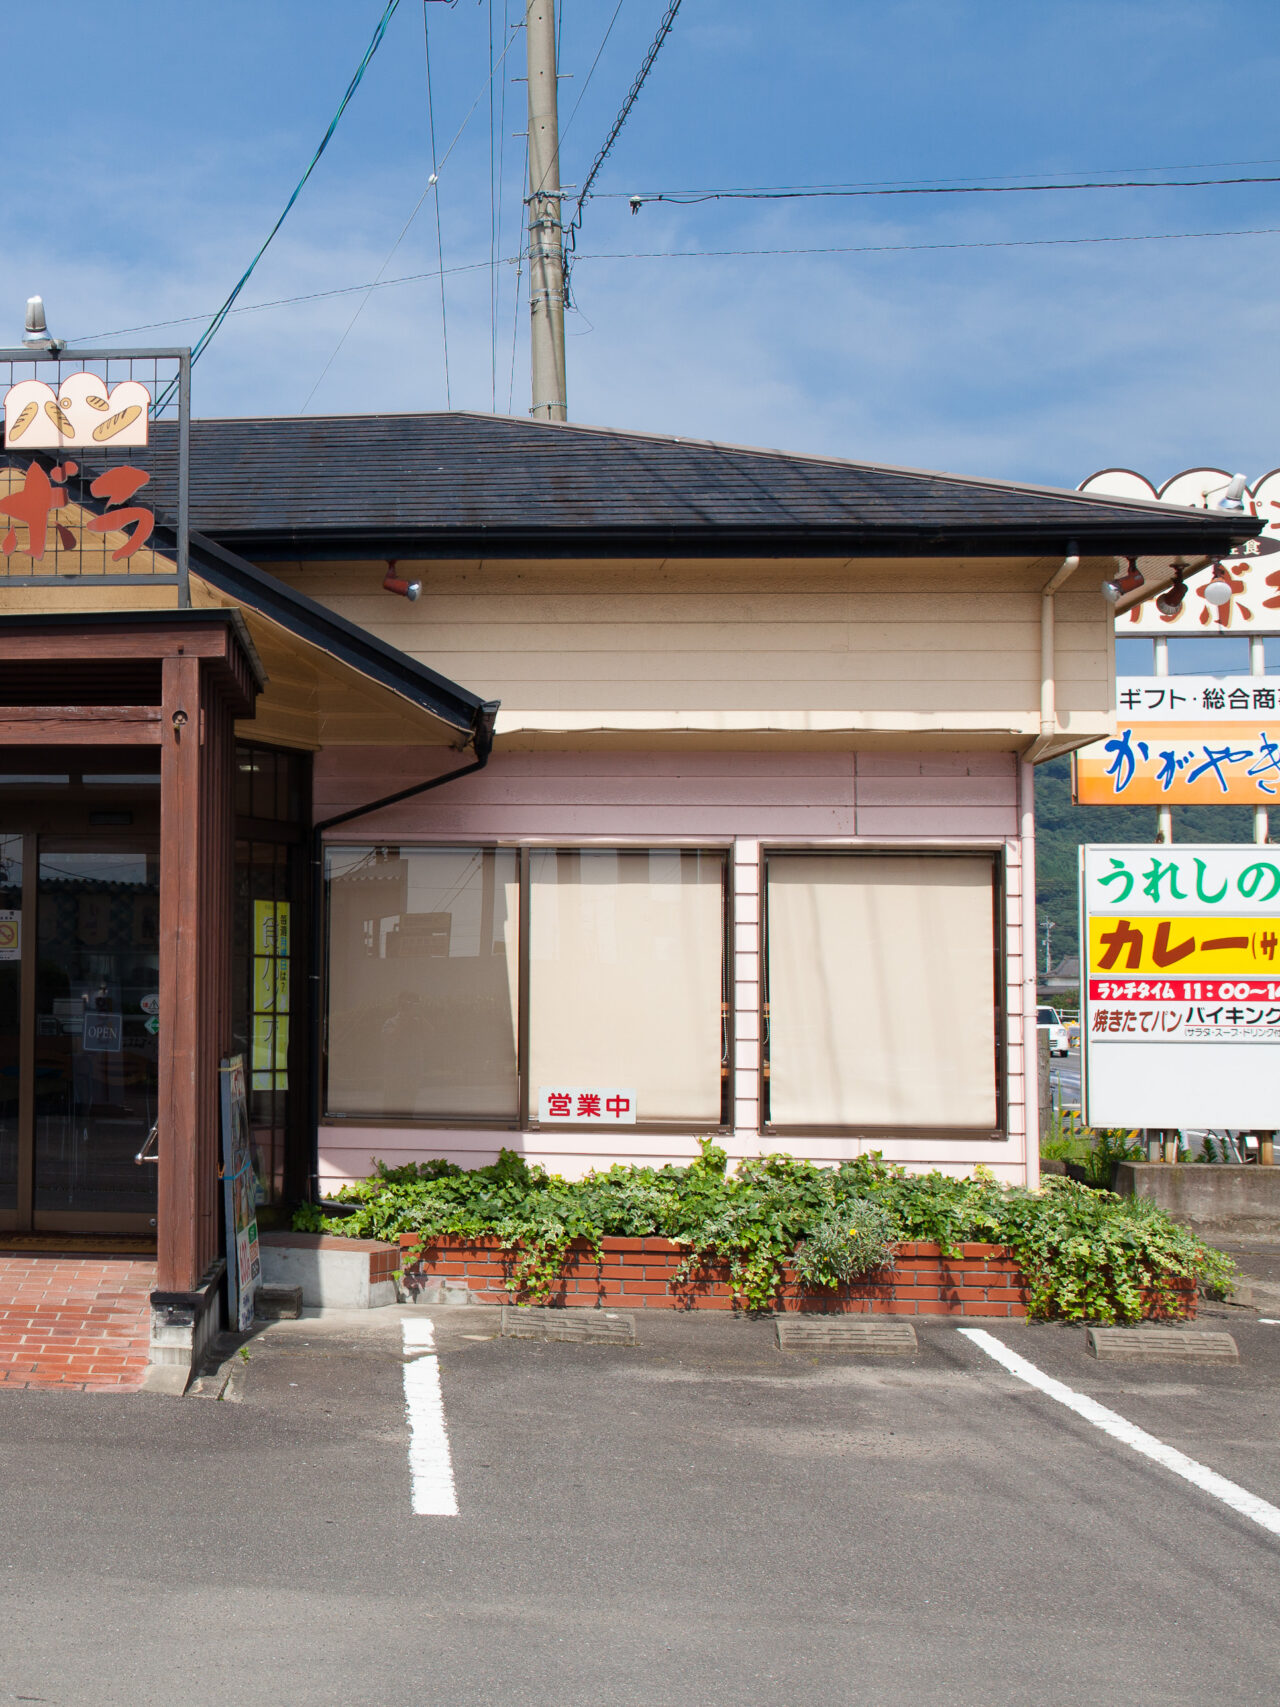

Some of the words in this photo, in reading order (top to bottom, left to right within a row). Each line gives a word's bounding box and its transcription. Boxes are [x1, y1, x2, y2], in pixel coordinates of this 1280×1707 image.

[1120, 688, 1280, 711] ギフト・総合商
[1105, 729, 1280, 794] かがやき
[1097, 858, 1280, 904] うれしの
[1098, 982, 1175, 999] ランチタイム
[1092, 1009, 1183, 1032] 焼きたてパン
[88, 1026, 118, 1039] OPEN
[548, 1093, 630, 1118] 営業中
